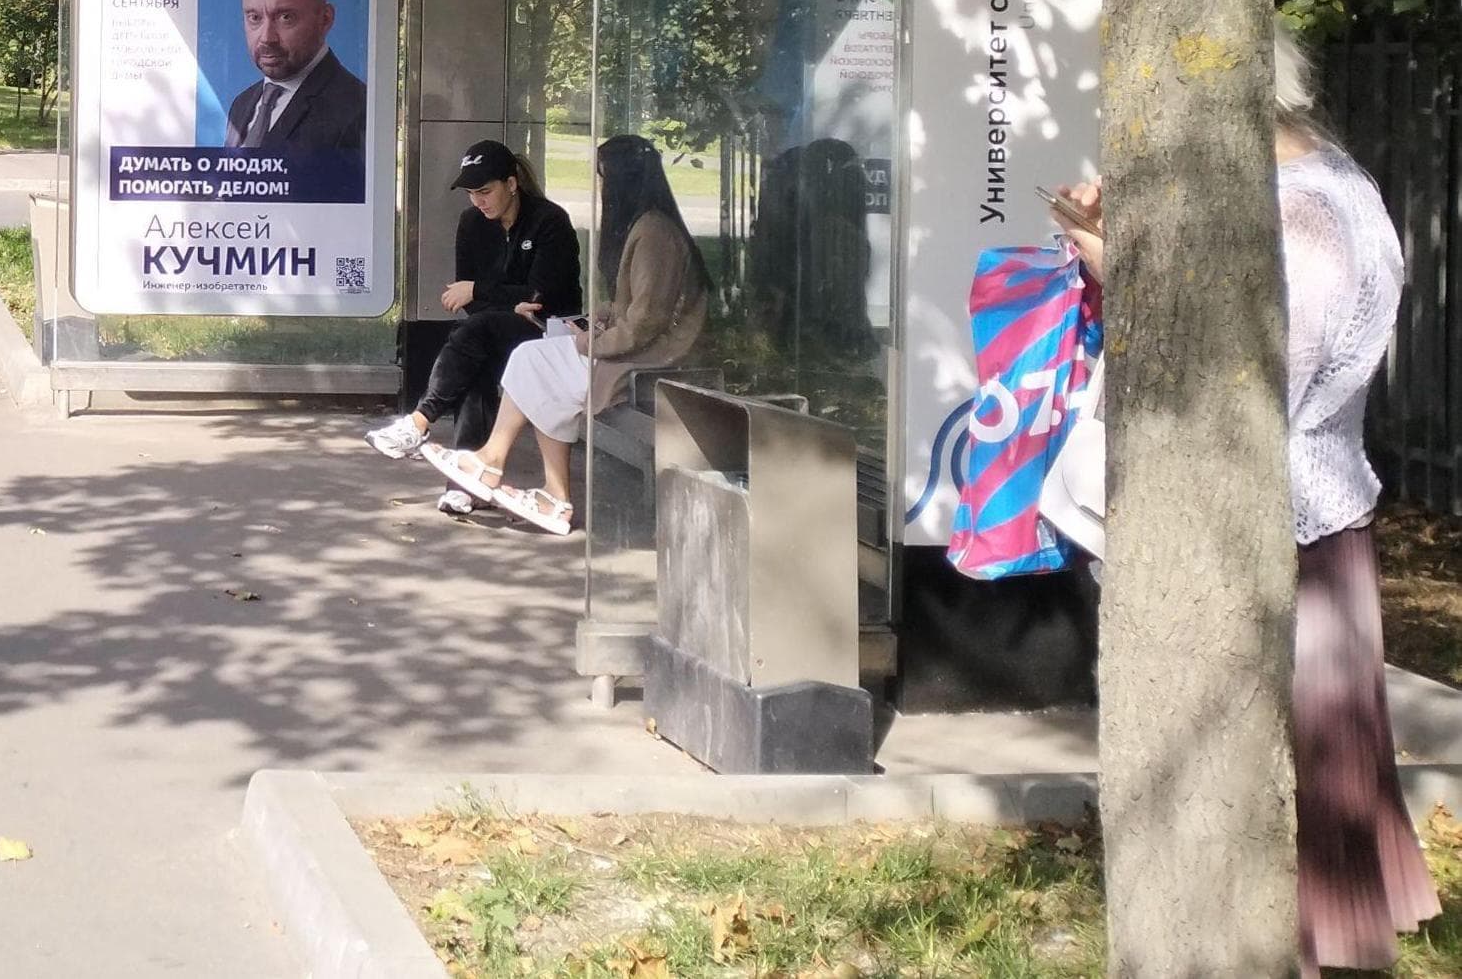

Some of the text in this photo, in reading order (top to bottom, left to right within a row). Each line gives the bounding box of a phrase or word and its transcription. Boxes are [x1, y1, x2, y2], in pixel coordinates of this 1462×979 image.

[979, 21, 1012, 224] Университет
[118, 156, 288, 174] ДУМАТЬ О ЛЮДЯХ,
[118, 179, 290, 197] ПОМОГАТЬ ДЕЛОМ!
[144, 214, 271, 240] Алексей
[143, 245, 316, 276] КУЧМИН
[142, 280, 268, 292] Инженер-изобретатель
